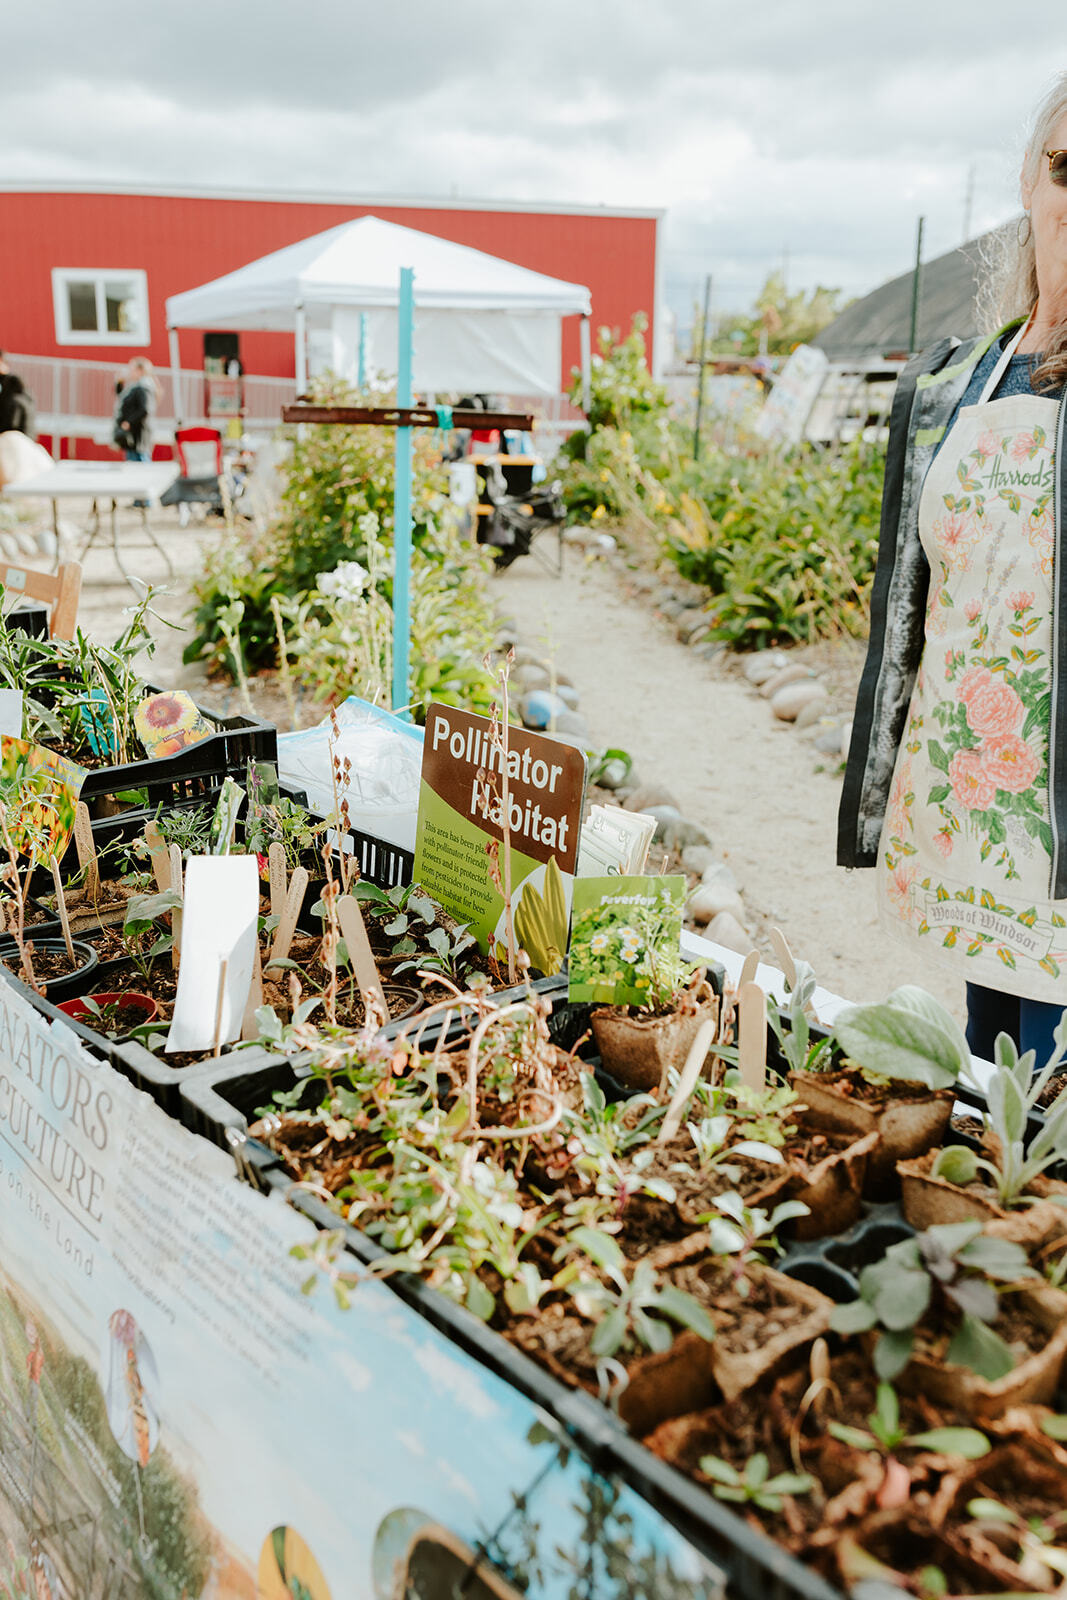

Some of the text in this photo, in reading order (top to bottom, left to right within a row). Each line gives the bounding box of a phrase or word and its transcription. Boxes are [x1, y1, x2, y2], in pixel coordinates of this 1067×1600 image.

[982, 454, 1053, 489] Harrods
[432, 716, 563, 793] Pollinator
[425, 820, 475, 849] This area has been
[470, 779, 569, 853] Habitat
[422, 848, 441, 865] flowers
[442, 860, 453, 870] and
[460, 868, 487, 885] protected
[424, 837, 436, 848] with
[436, 841, 488, 873] pollinator-friendly
[421, 878, 442, 894] valuable
[443, 887, 462, 903] habitat
[463, 897, 472, 908] for
[473, 900, 486, 915] bees
[422, 862, 493, 903] from pesticides to provide
[931, 904, 1040, 952] Woods of Windsor
[27, 1190, 51, 1231] the
